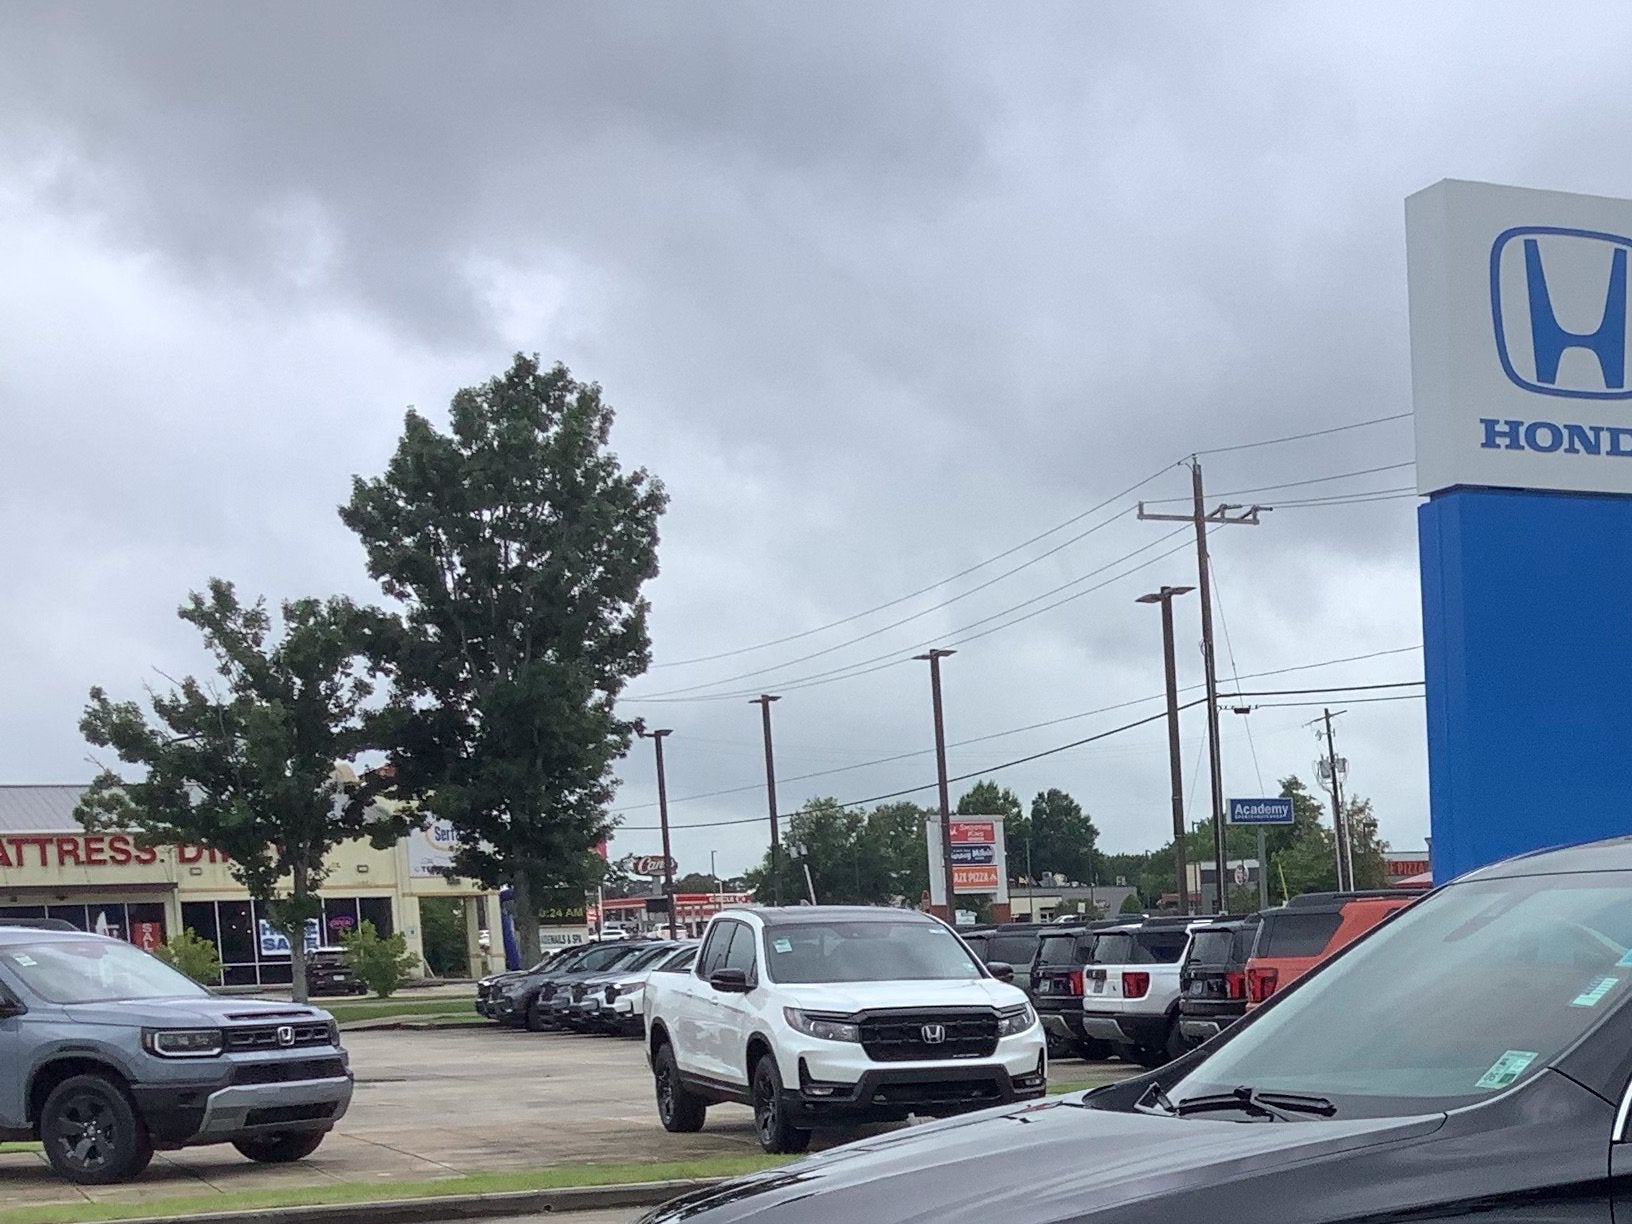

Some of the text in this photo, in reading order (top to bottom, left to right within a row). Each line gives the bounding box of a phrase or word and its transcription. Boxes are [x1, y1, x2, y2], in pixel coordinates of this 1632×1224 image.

[1234, 803, 1289, 817] Academy
[968, 872, 989, 883] PIZZA
[565, 907, 584, 917] AM
